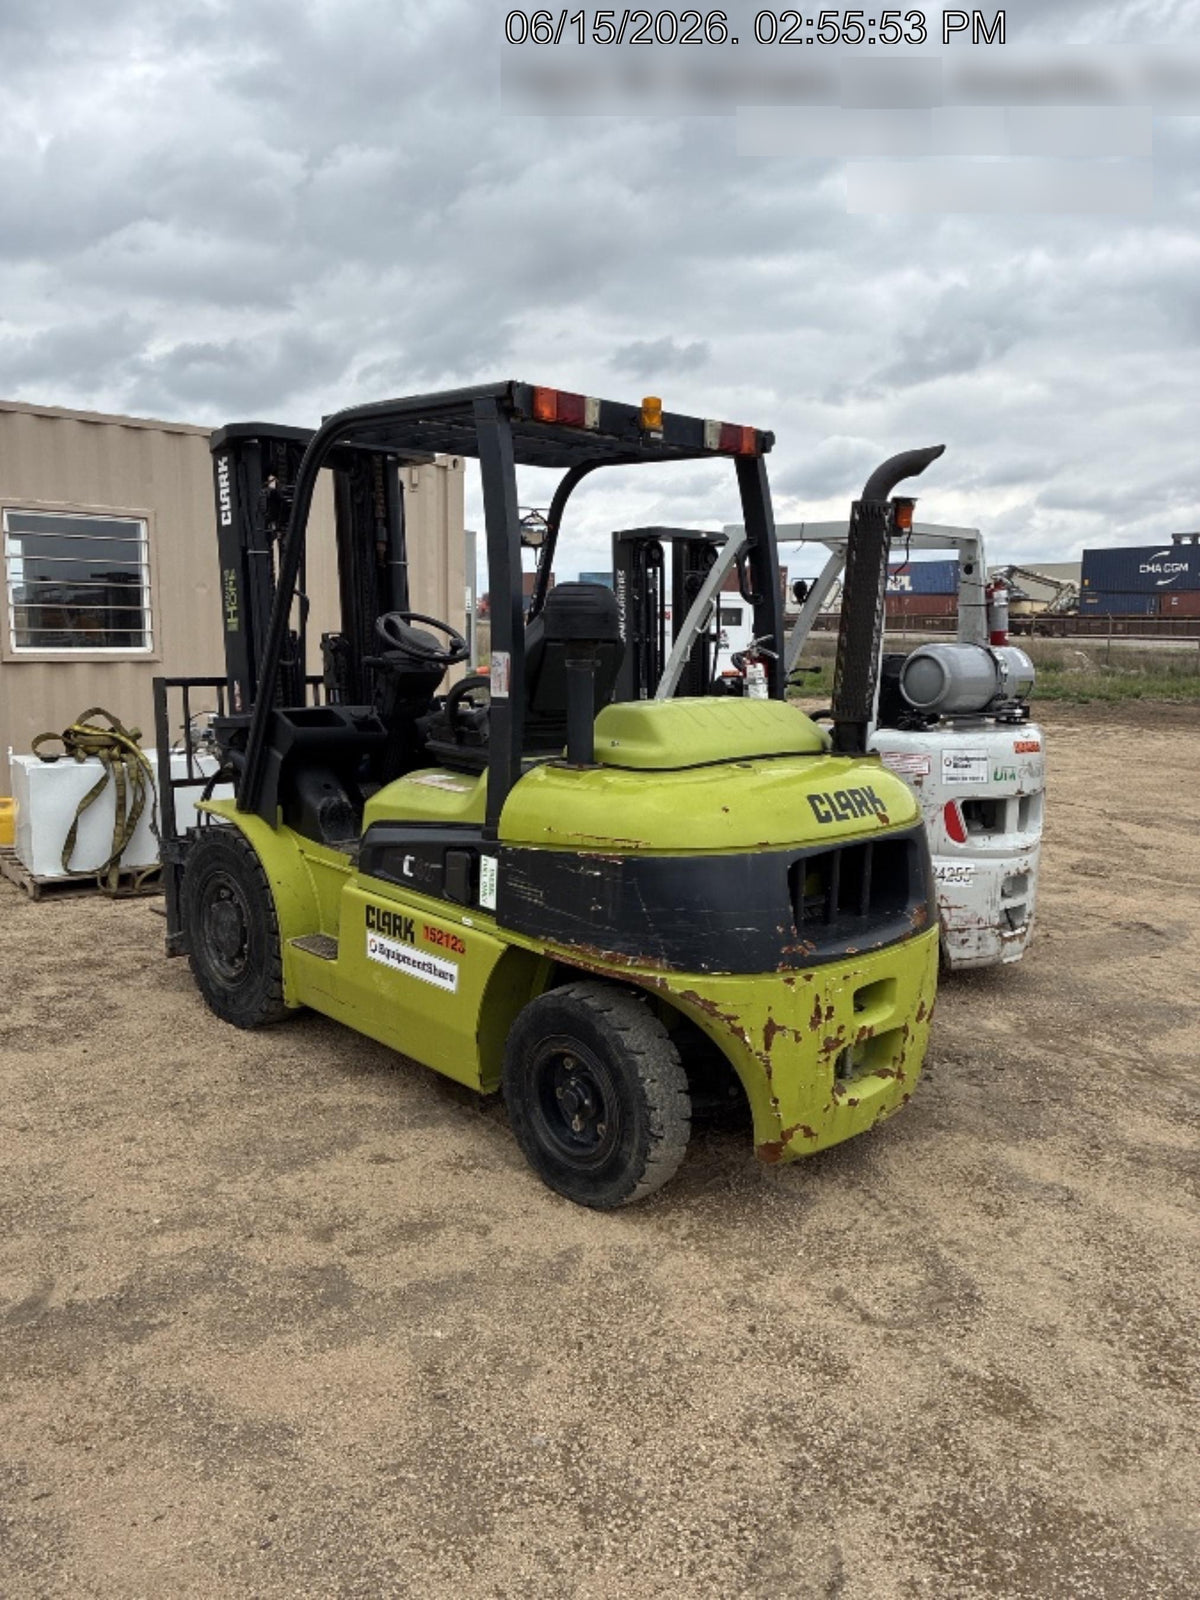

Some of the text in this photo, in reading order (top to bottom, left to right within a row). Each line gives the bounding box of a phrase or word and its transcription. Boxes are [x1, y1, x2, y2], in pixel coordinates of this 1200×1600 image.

[217, 456, 232, 526] CLARK
[1162, 562, 1189, 573] CGM
[806, 785, 887, 824] CLARK
[365, 904, 415, 944] CLARK
